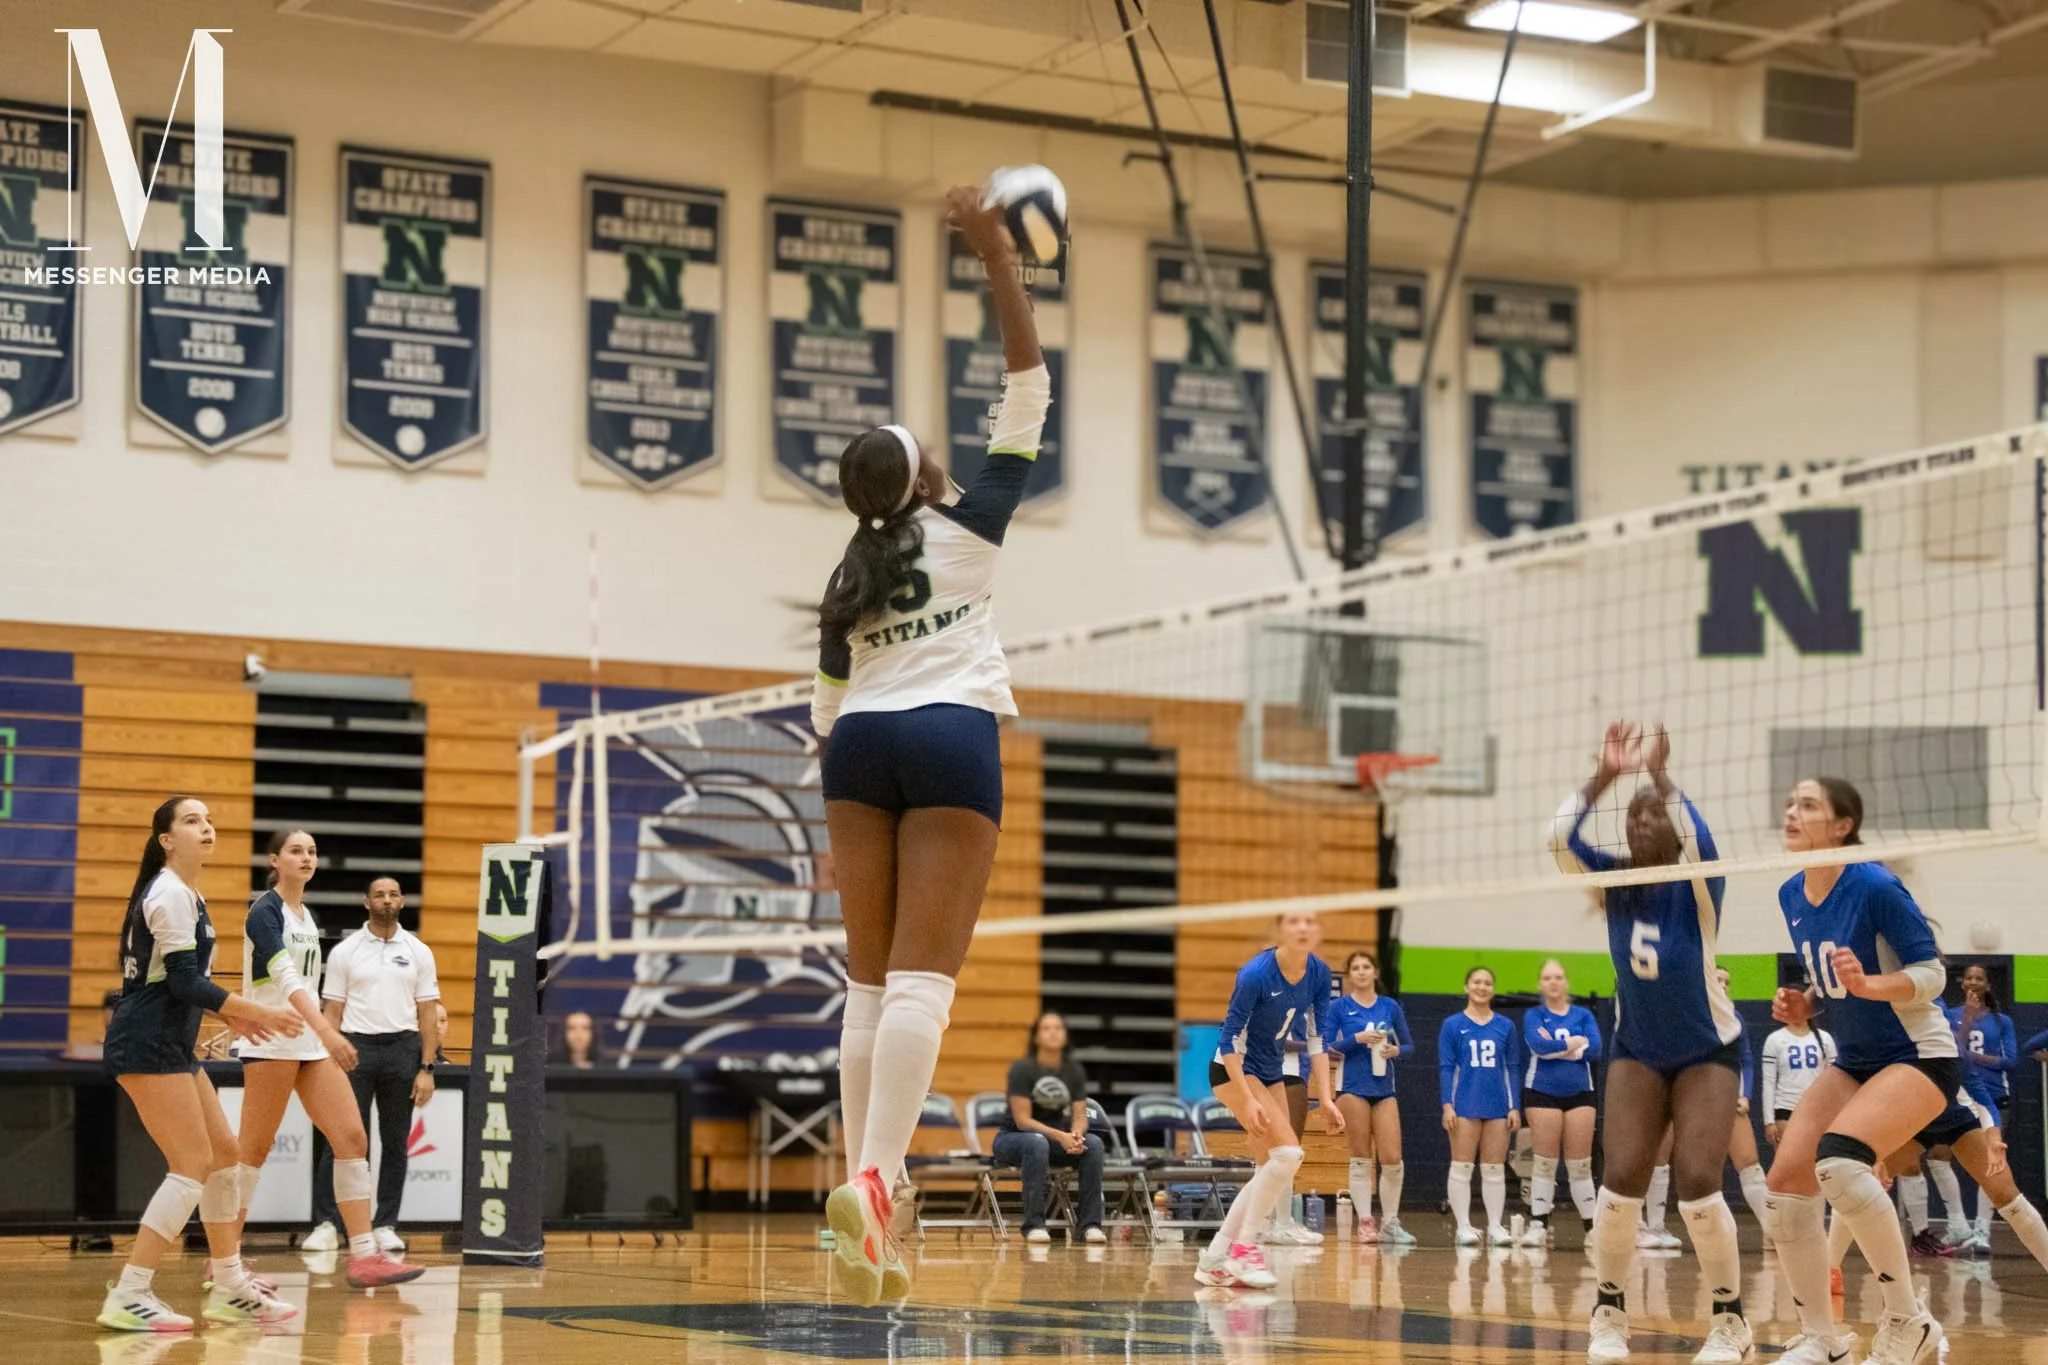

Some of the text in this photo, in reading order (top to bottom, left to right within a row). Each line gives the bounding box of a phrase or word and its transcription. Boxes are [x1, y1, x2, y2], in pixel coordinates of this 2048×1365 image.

[378, 217, 452, 294] N
[619, 243, 689, 320] N
[1698, 505, 1864, 658] N
[485, 860, 533, 917] N
[302, 948, 317, 977] 11
[1630, 919, 1661, 981] 5
[1801, 941, 1848, 1000] 10
[1469, 1039, 1497, 1068] 12
[1787, 1044, 1819, 1069] 26
[479, 959, 517, 1238] TITANS
